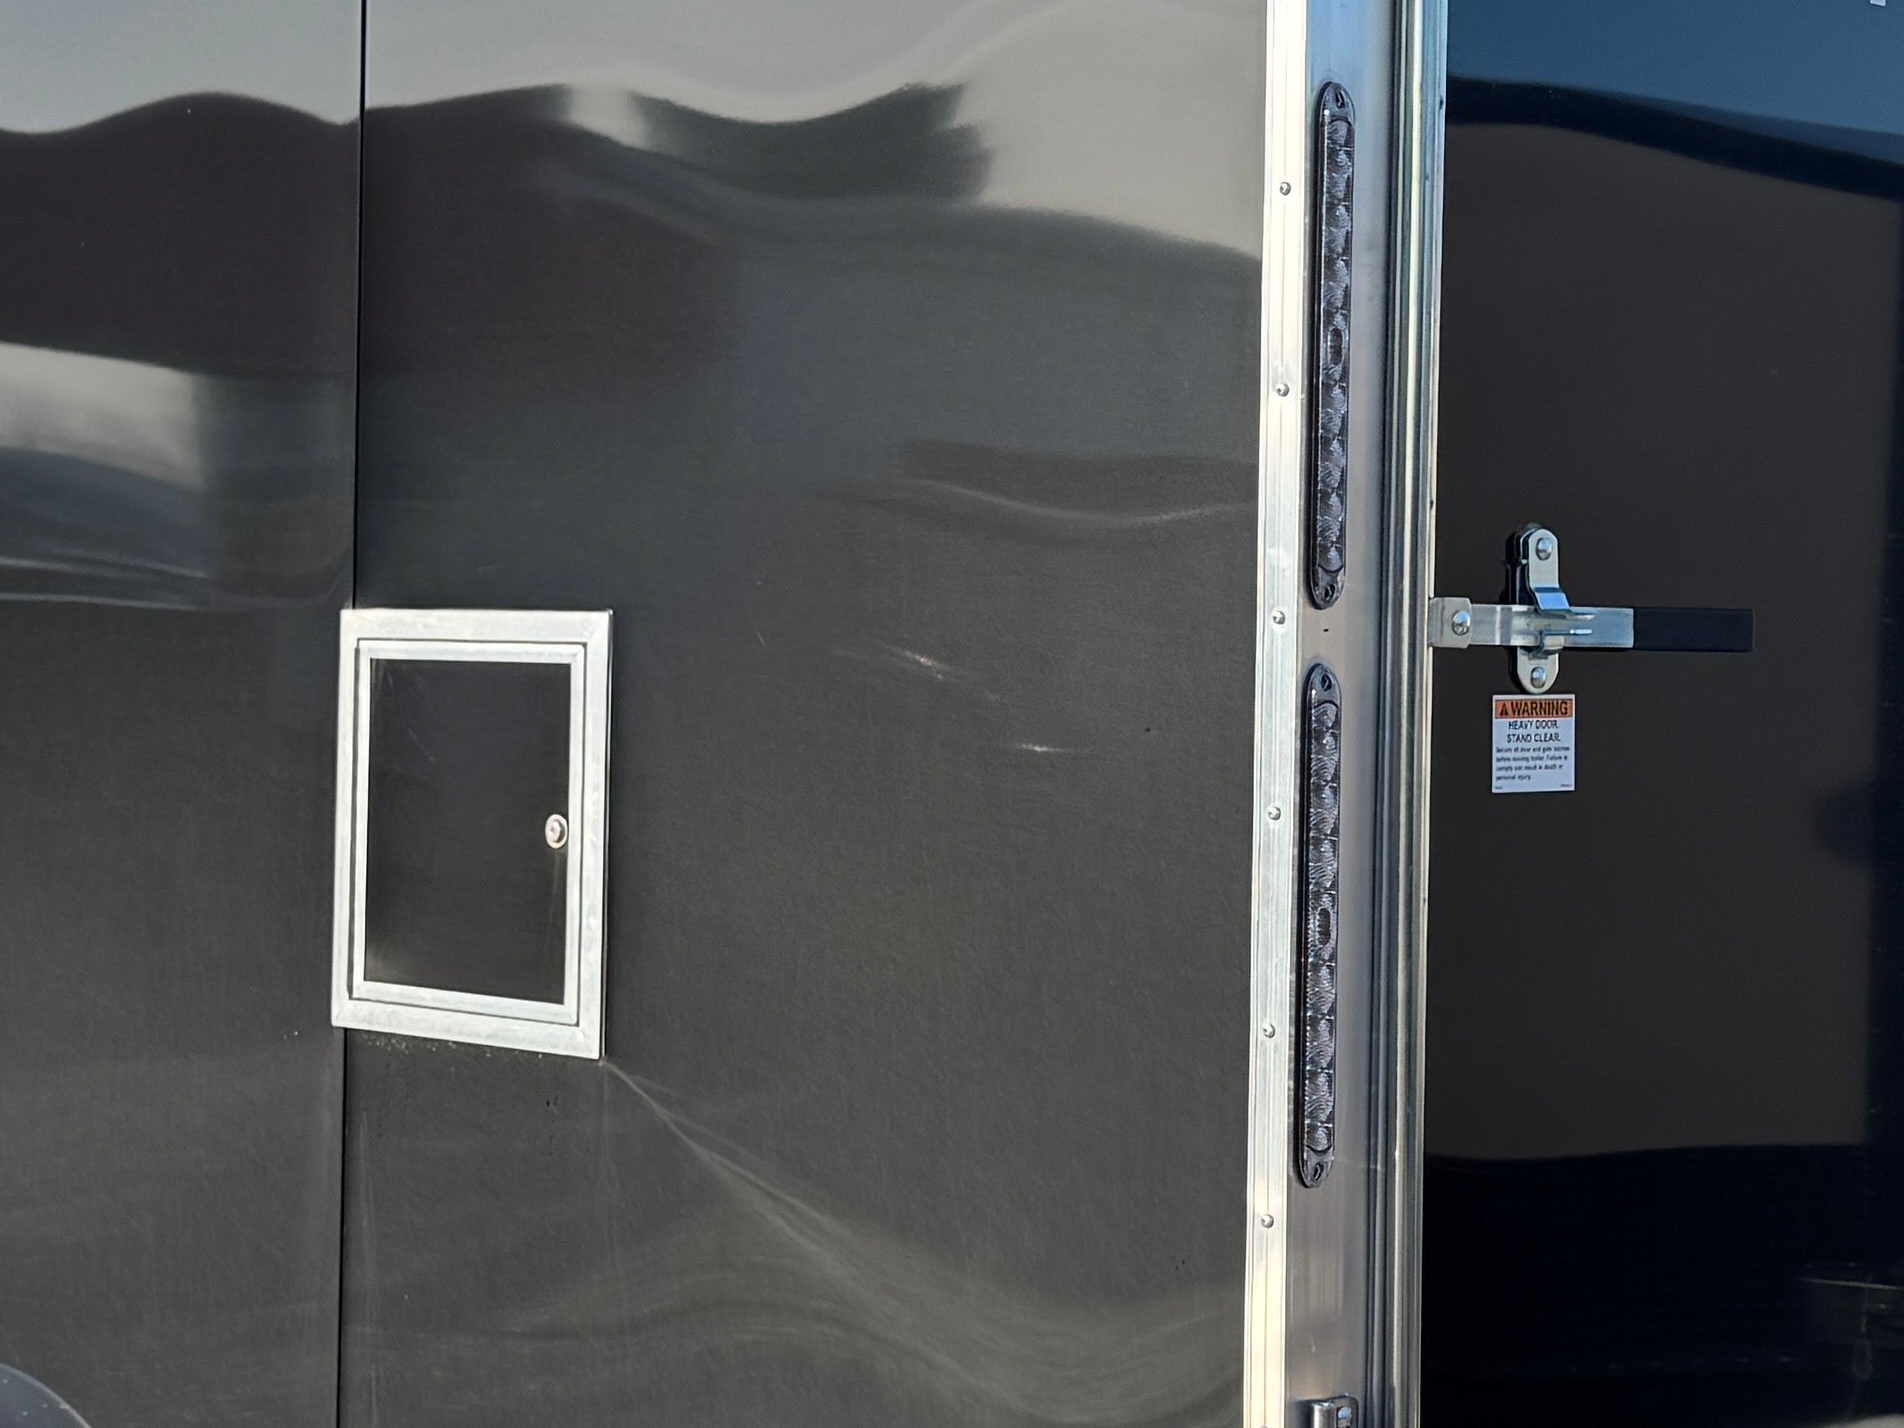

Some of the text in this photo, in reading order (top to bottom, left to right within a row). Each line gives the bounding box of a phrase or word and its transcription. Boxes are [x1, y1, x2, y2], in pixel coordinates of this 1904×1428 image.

[1510, 700, 1568, 716] WARNING
[1508, 719, 1559, 730] HEAVY DOOR
[1506, 732, 1561, 744] STAND CLEAR
